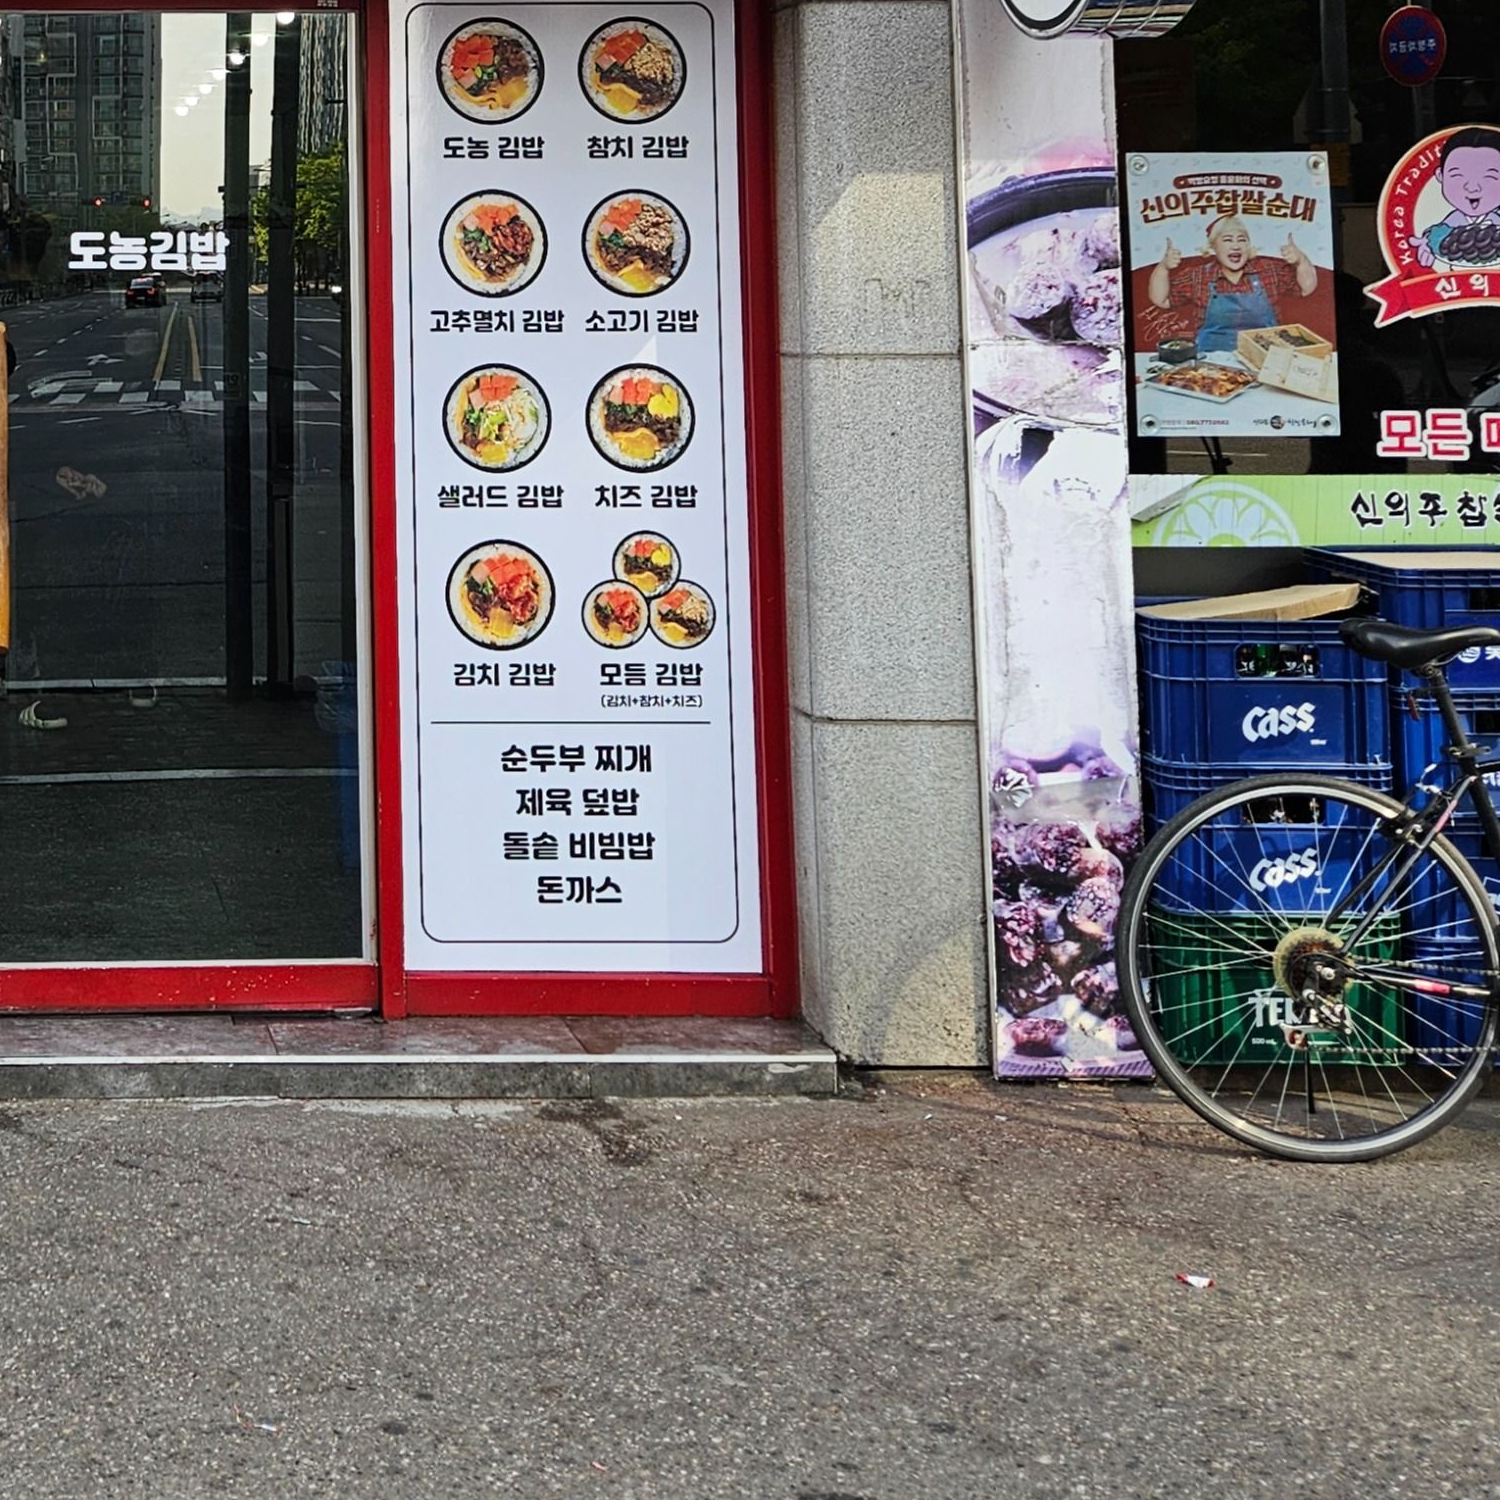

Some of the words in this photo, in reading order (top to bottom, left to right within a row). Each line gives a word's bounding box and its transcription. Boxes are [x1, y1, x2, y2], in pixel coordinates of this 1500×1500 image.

[443, 136, 490, 160] 도농
[497, 135, 545, 160] 김밥
[587, 135, 634, 159] 참치
[641, 135, 690, 159] 김밥
[1396, 140, 1447, 196] Tradit
[1140, 188, 1318, 224] 신의주찹쌀순대
[1393, 205, 1414, 266] Korea
[69, 231, 230, 271] 도농김밥
[429, 309, 515, 333] 고추멸치
[522, 309, 565, 333] 김밥
[585, 309, 649, 333] 소고기
[656, 309, 699, 333] 김밥
[1380, 411, 1470, 458] 모든
[437, 484, 509, 509] 샐러드
[516, 484, 565, 509] 김밥
[594, 484, 642, 508] 치즈
[650, 484, 698, 509] 김밥
[453, 662, 500, 687] 김치
[508, 662, 557, 687] 김밥
[599, 663, 647, 687] 모듬
[655, 662, 703, 687] 김밥
[1242, 702, 1316, 742] Cass
[500, 744, 586, 773] 순두부
[594, 744, 652, 773] 찌개
[515, 787, 573, 816] 제육
[582, 787, 640, 816] 덮밥
[502, 831, 559, 860] 돌솥
[569, 831, 656, 861] 비빔밥
[1250, 848, 1318, 892] Cass
[536, 875, 623, 904] 돈까스
